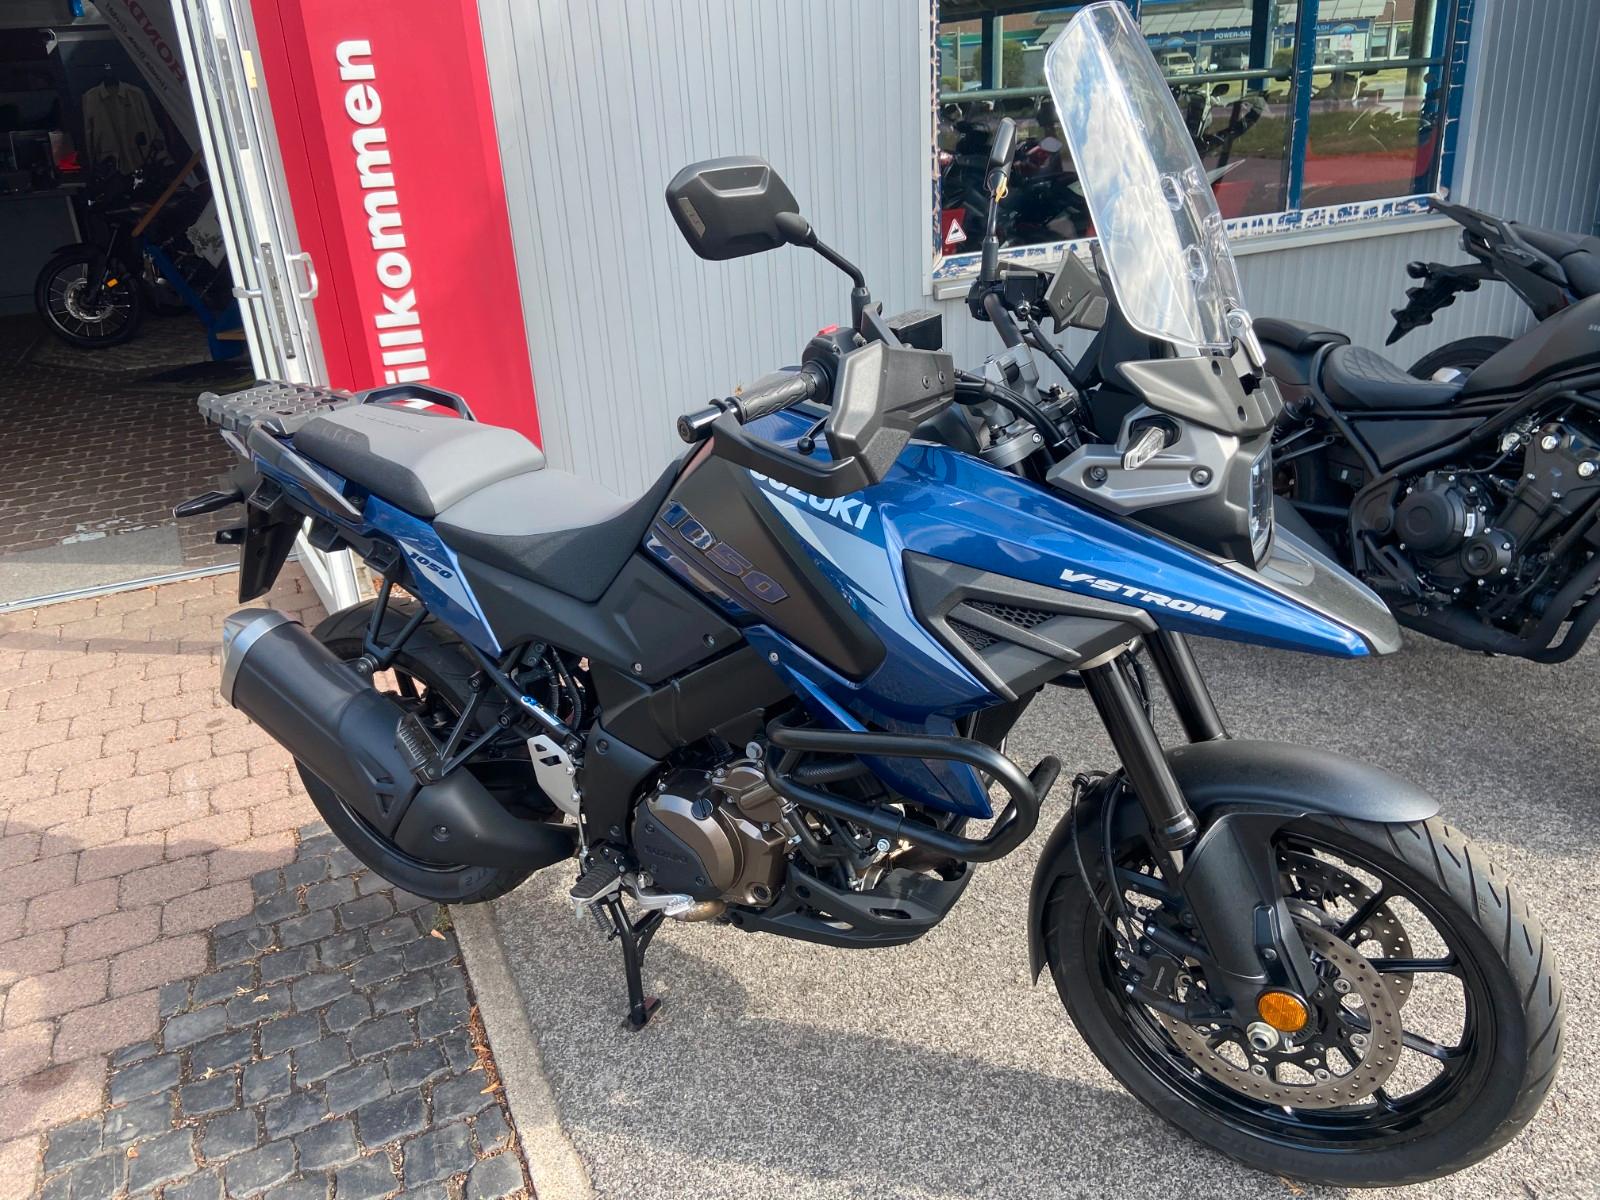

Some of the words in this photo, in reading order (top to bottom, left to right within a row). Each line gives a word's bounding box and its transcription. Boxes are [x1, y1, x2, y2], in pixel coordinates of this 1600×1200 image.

[336, 39, 434, 409] illkommen
[409, 551, 453, 579] 1050
[660, 499, 790, 604] 1050
[1059, 568, 1226, 622] V-STROM
